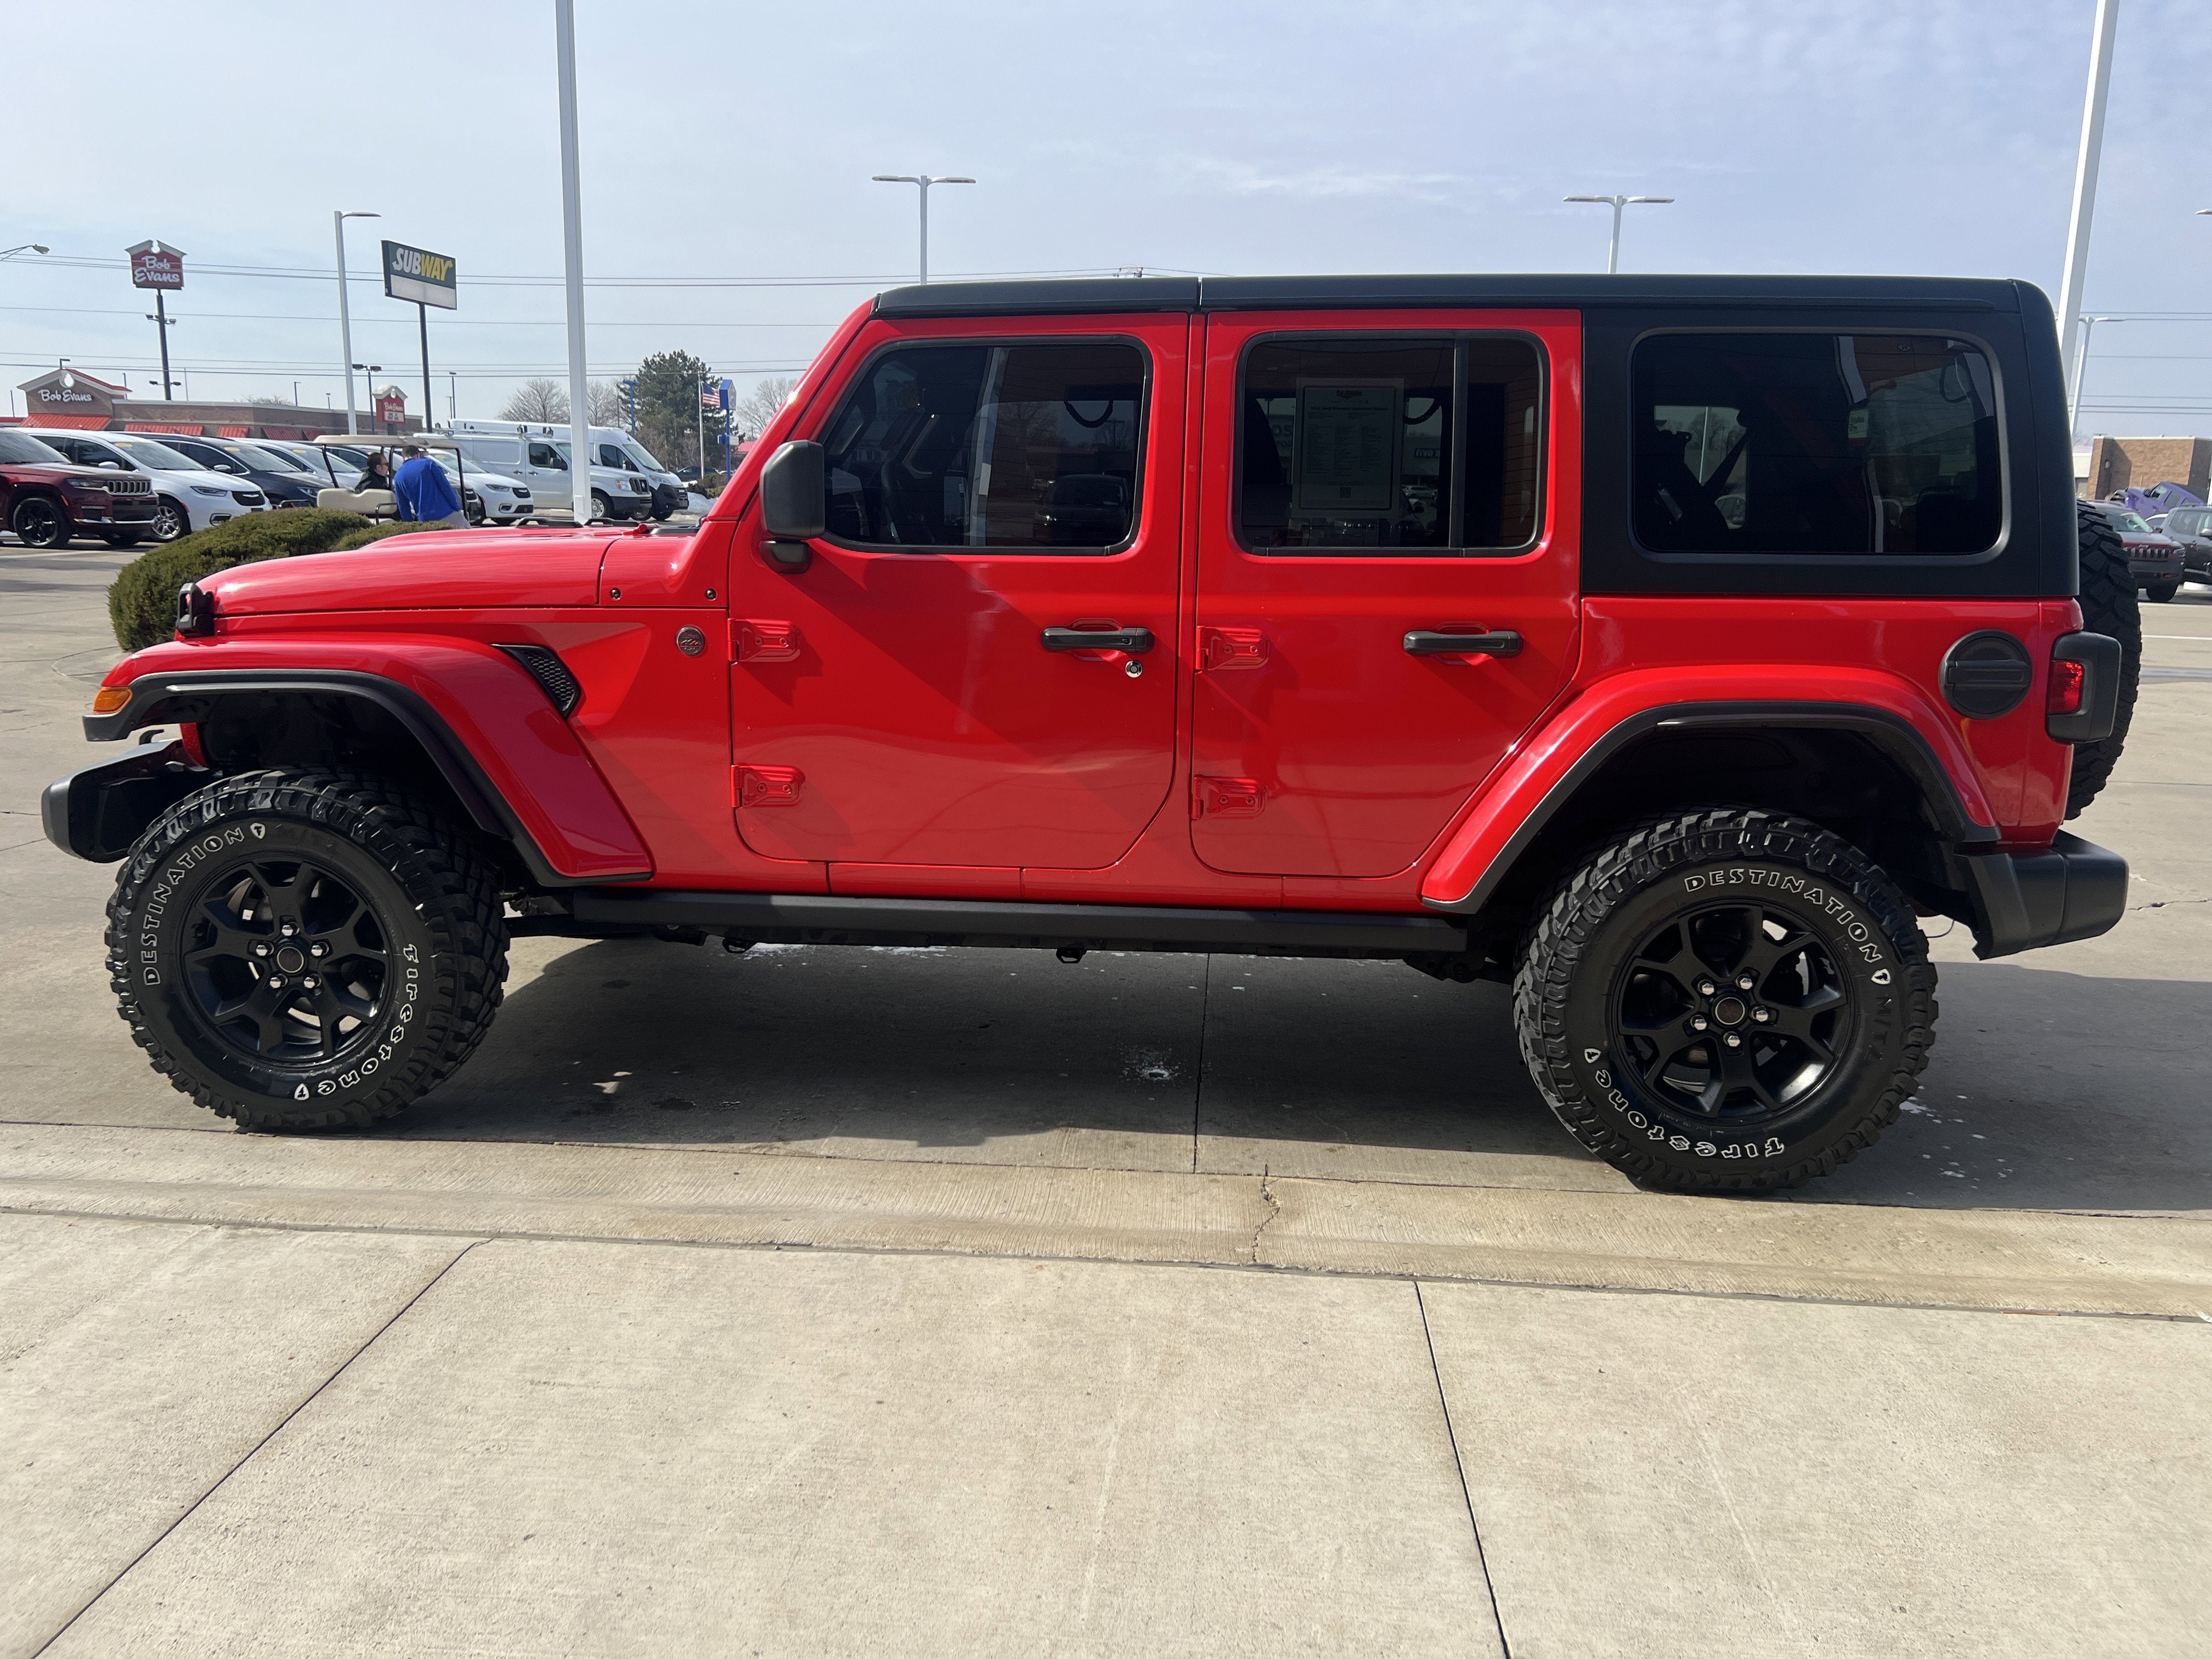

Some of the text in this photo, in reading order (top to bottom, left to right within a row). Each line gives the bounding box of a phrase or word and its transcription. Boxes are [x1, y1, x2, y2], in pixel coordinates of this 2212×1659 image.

[141, 255, 170, 269] Bob
[392, 247, 453, 281] SUBWAY
[134, 267, 180, 283] Evans
[37, 389, 93, 403] Bob Evans
[141, 826, 245, 986] DESTINATION
[1684, 868, 1884, 963] DESTINATION
